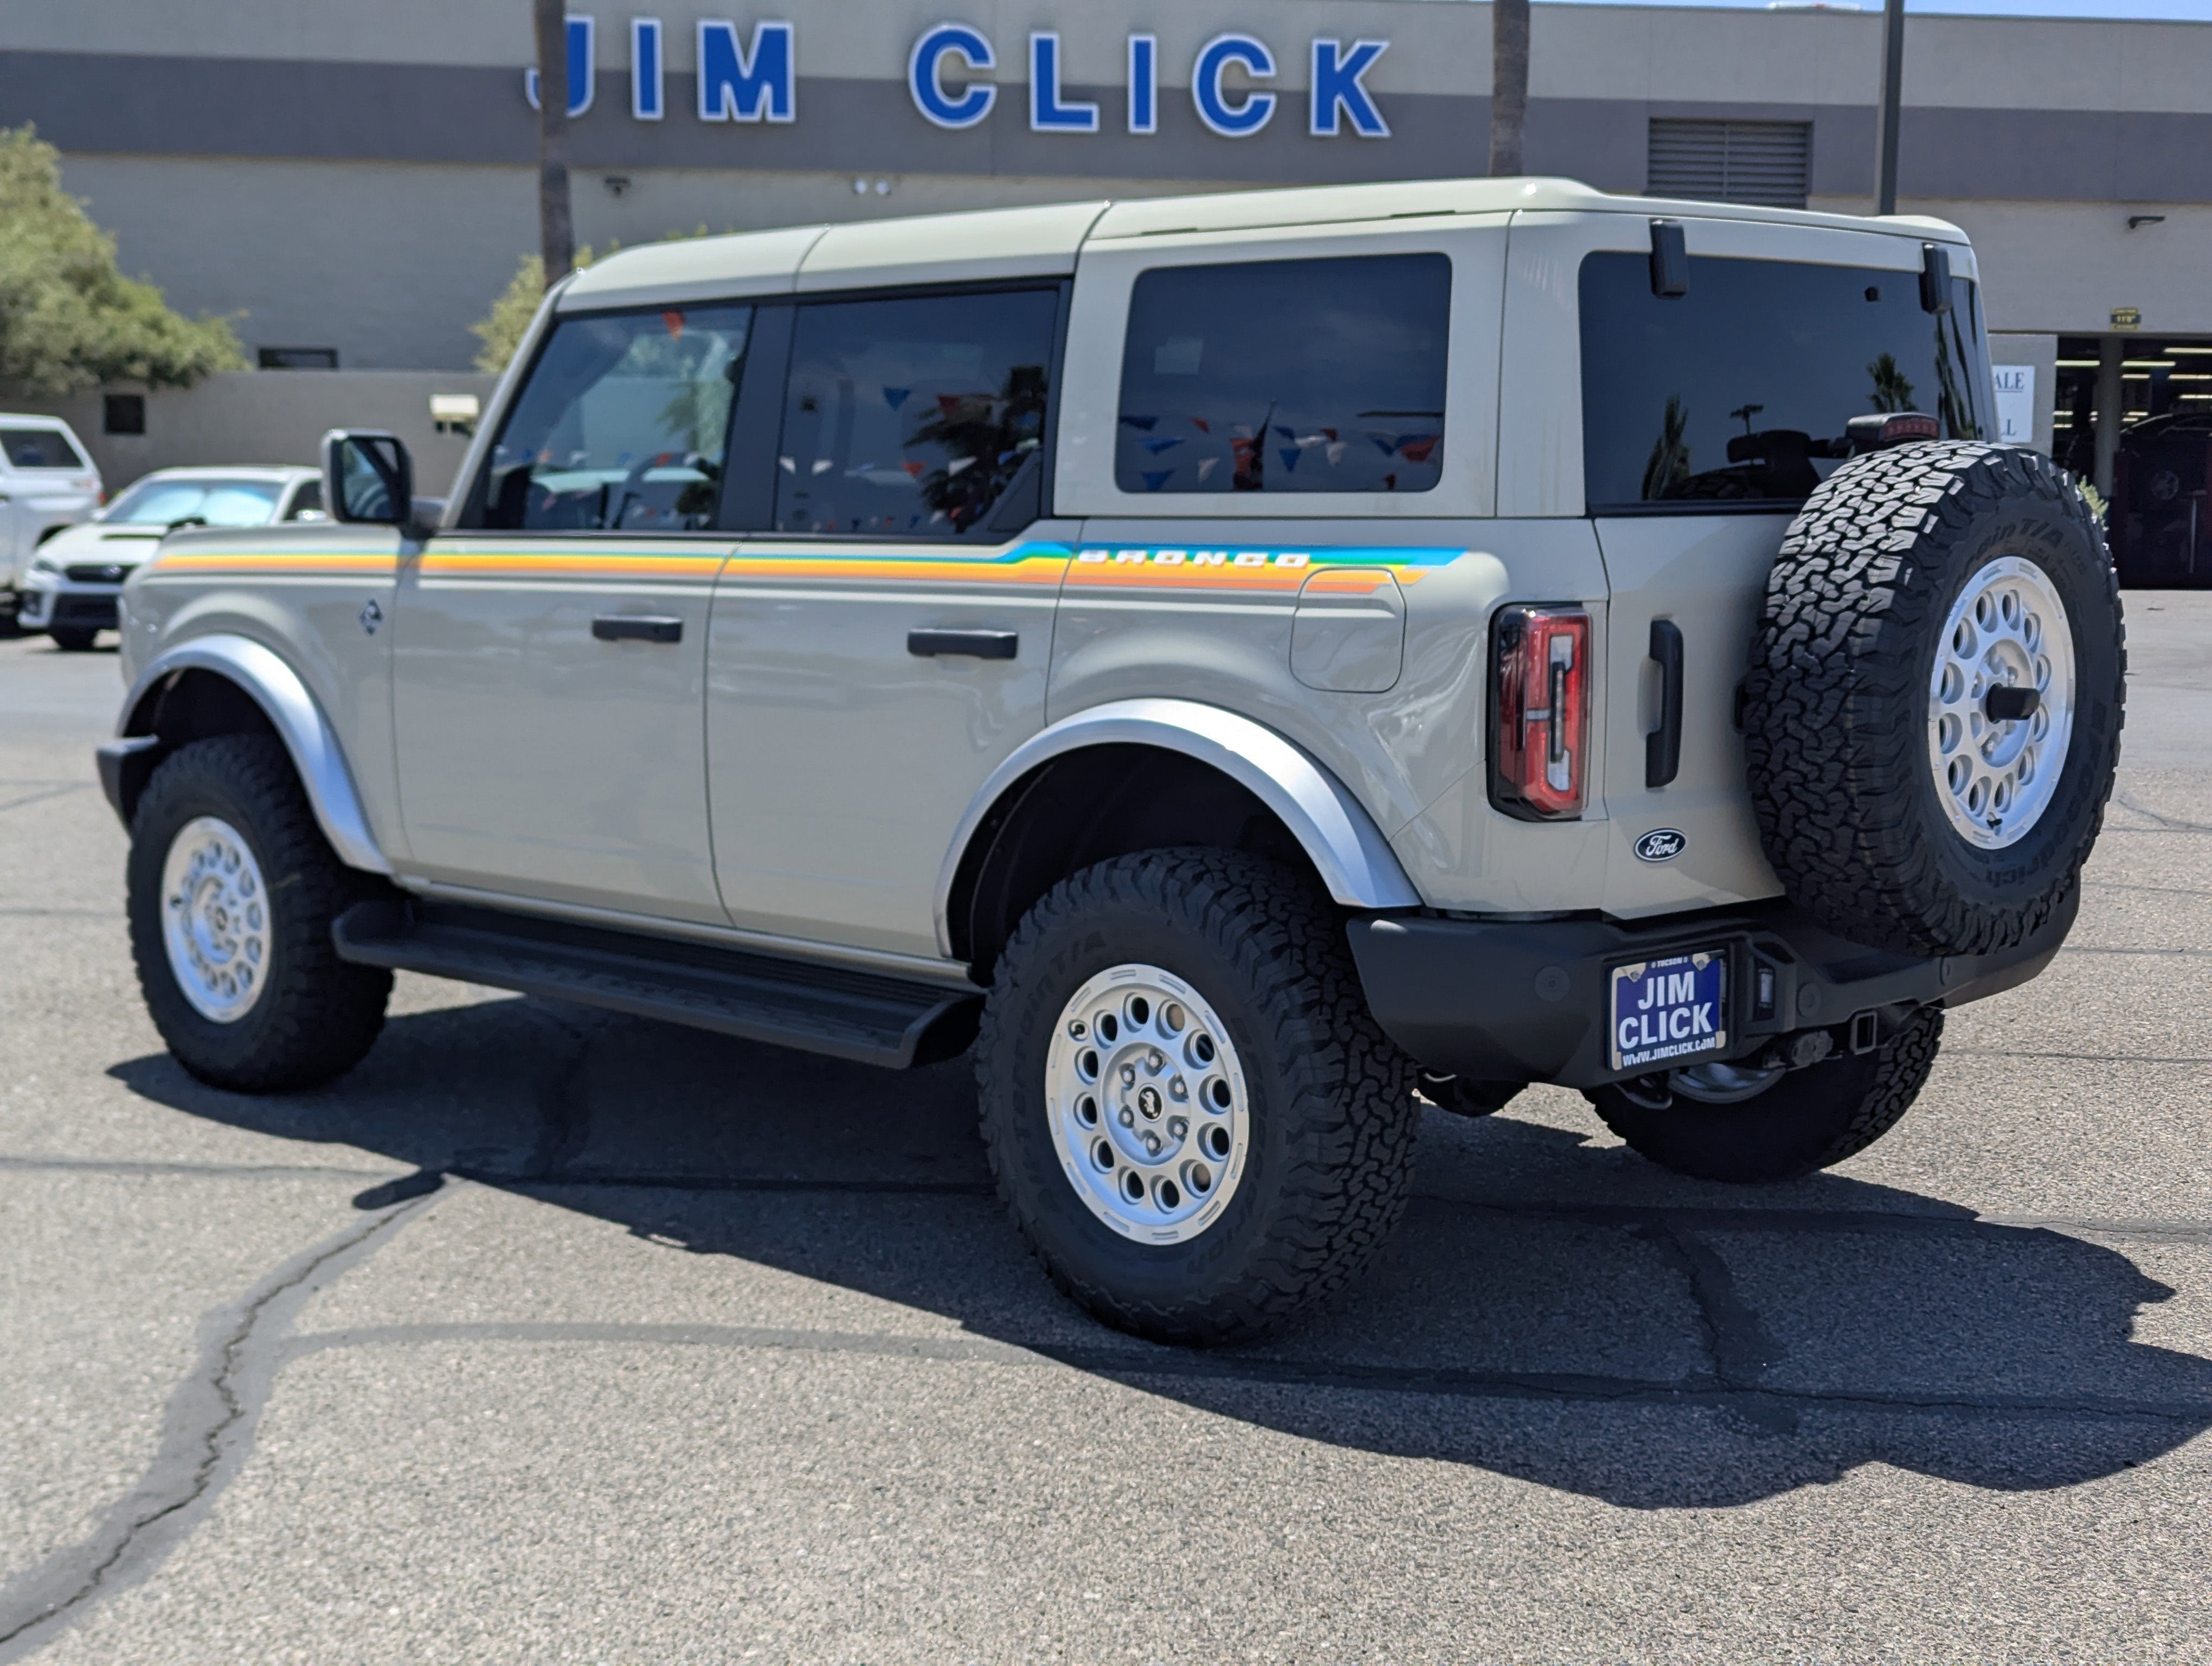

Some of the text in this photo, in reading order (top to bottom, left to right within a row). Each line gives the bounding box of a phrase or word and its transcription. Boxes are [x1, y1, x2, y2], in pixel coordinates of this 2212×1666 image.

[525, 15, 1393, 138] JIM CLICK
[1077, 549, 1311, 568] BRONCO
[1645, 835, 1680, 856] Ford
[1637, 971, 1695, 1010] JIM
[1618, 1002, 1713, 1049] CLICK
[1622, 1036, 1715, 1067] WWW.JIMCLICK.COM
